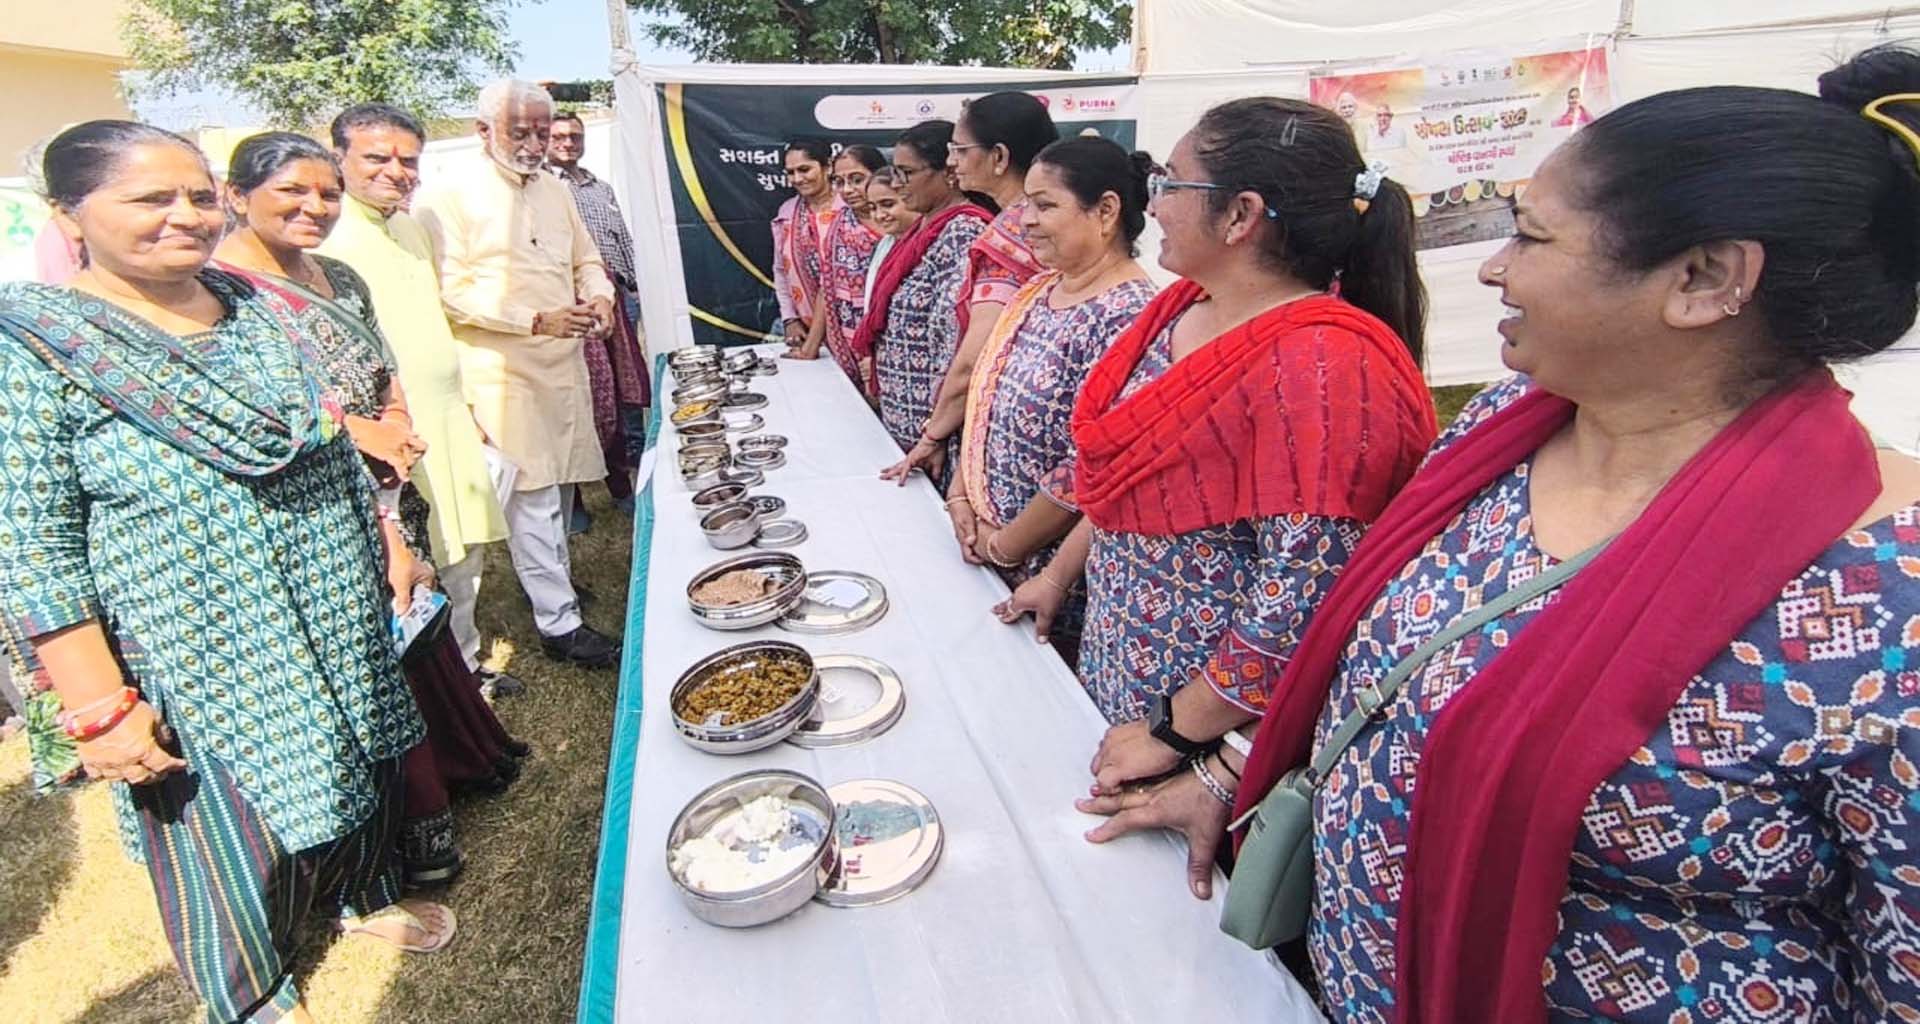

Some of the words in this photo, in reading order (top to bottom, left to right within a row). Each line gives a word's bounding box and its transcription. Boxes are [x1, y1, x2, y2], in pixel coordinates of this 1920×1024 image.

[1079, 99, 1115, 107] PURNA
[719, 148, 780, 165] સશક્ત
[757, 169, 793, 191] સુપો
